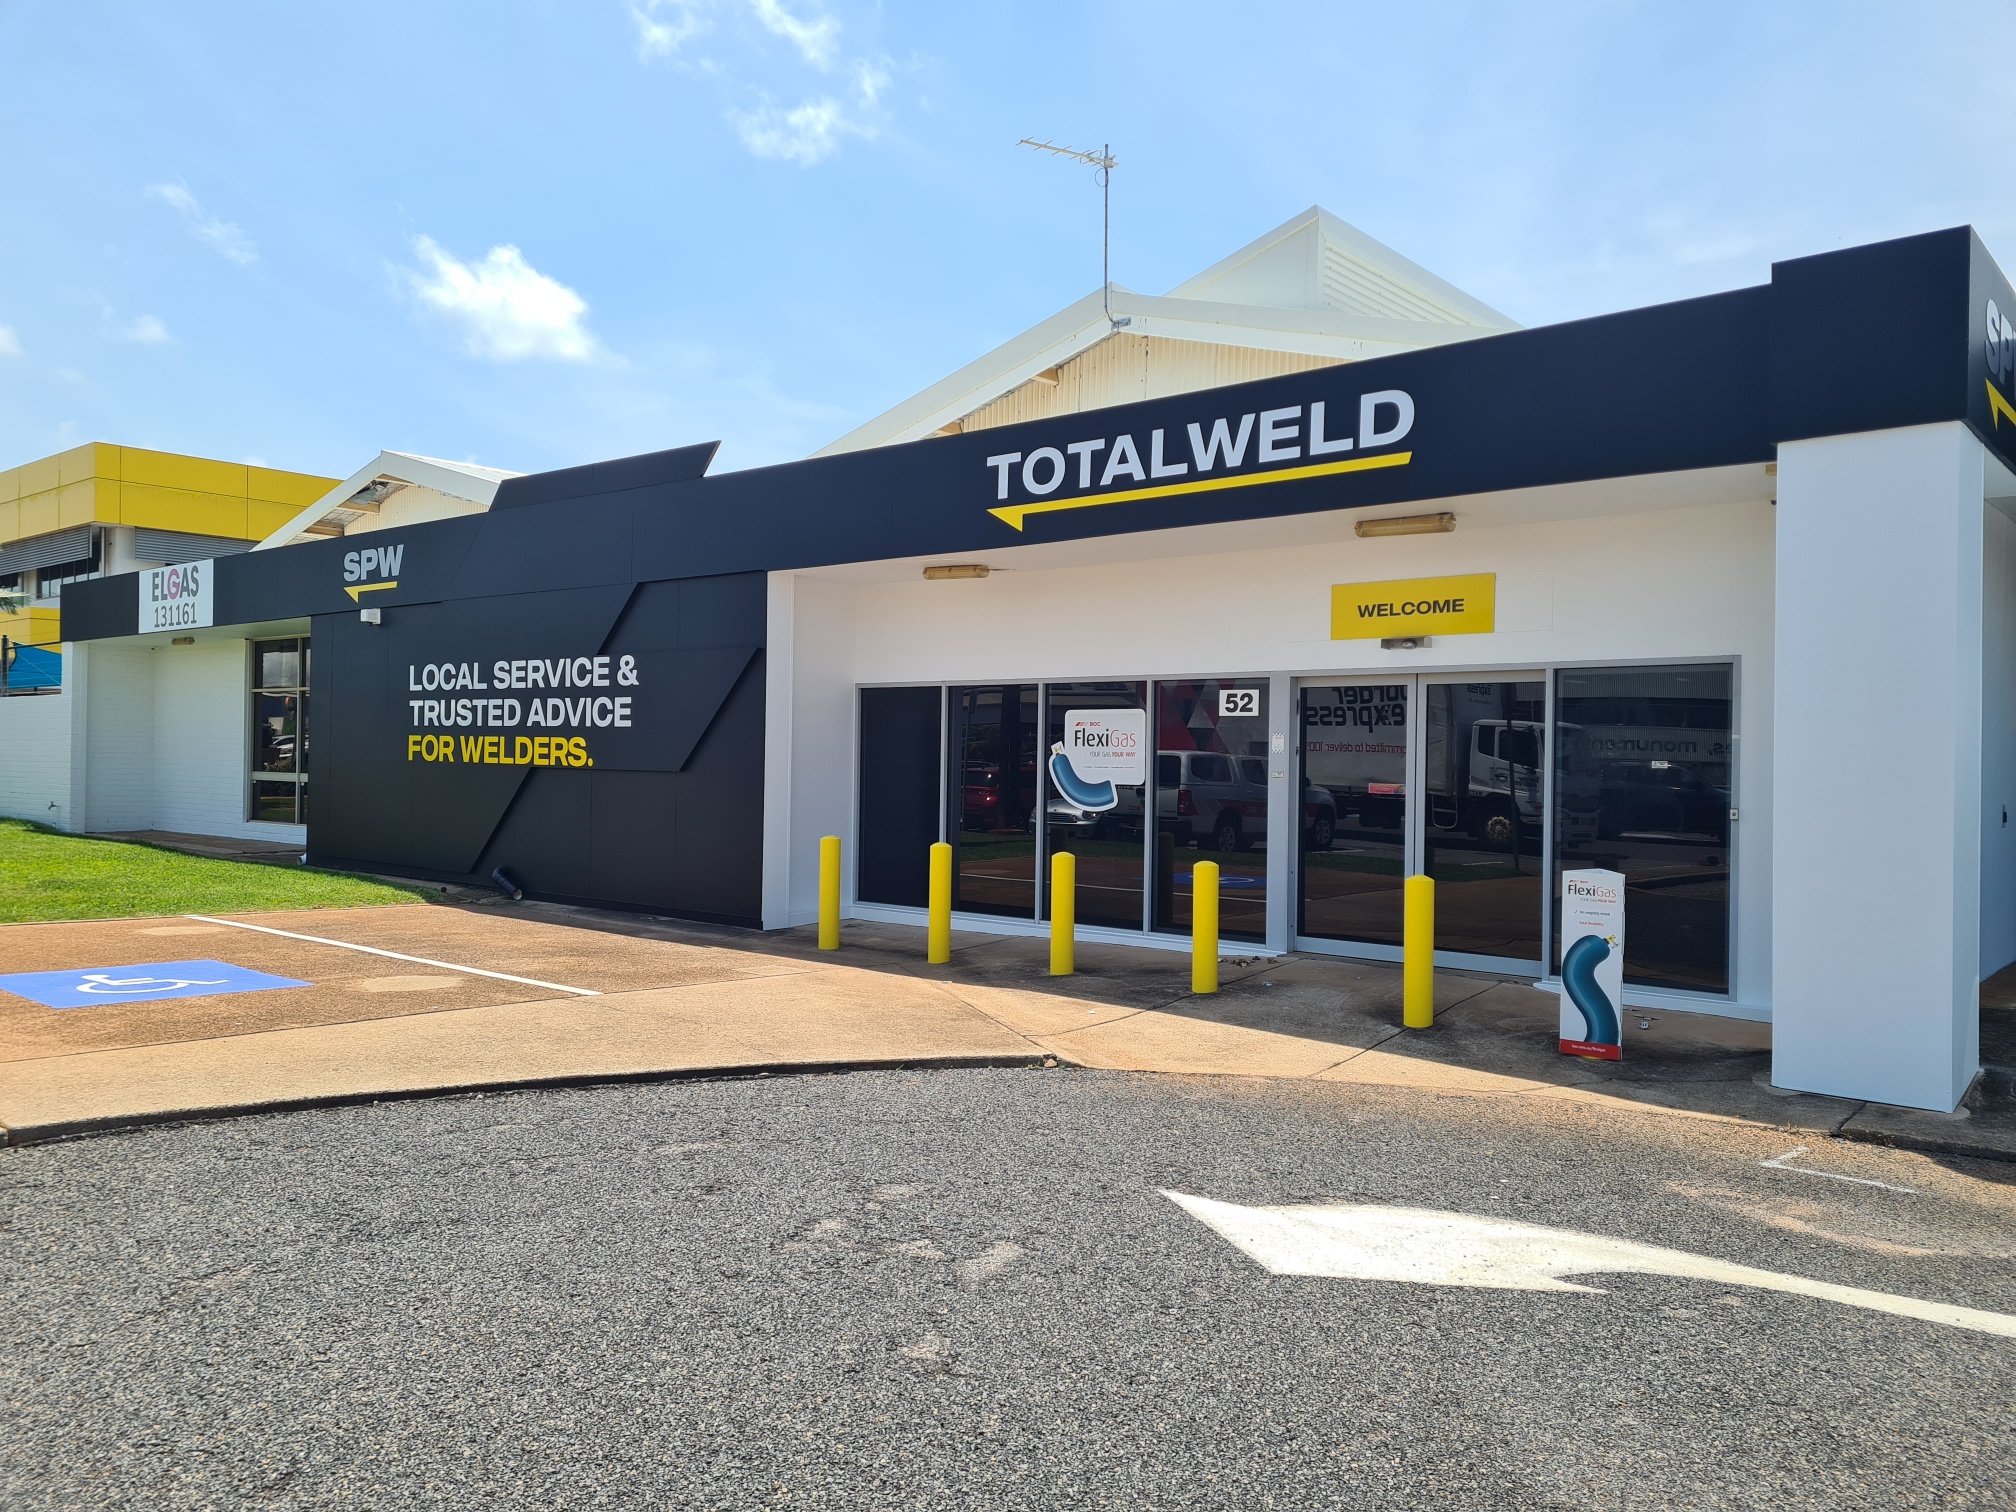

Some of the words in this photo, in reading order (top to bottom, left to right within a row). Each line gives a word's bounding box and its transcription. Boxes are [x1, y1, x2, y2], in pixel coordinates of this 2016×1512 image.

[1984, 298, 2016, 400] SP
[986, 388, 1416, 500] TOTALWELD
[343, 544, 404, 582] SPW
[152, 565, 199, 602] ELGAS
[154, 602, 197, 628] 131161
[1356, 597, 1465, 618] WELCOME
[409, 662, 487, 691] LOCAL
[493, 656, 610, 690] SERVICE
[616, 654, 640, 686] &
[409, 698, 521, 727] TRUSTED
[526, 696, 632, 727] ADVICE
[1224, 692, 1254, 712] 52
[408, 734, 454, 762] FOR
[460, 736, 594, 767] WELDERS.
[1074, 728, 1136, 748] FlexiGas
[1568, 884, 1616, 898] FlexiGas
